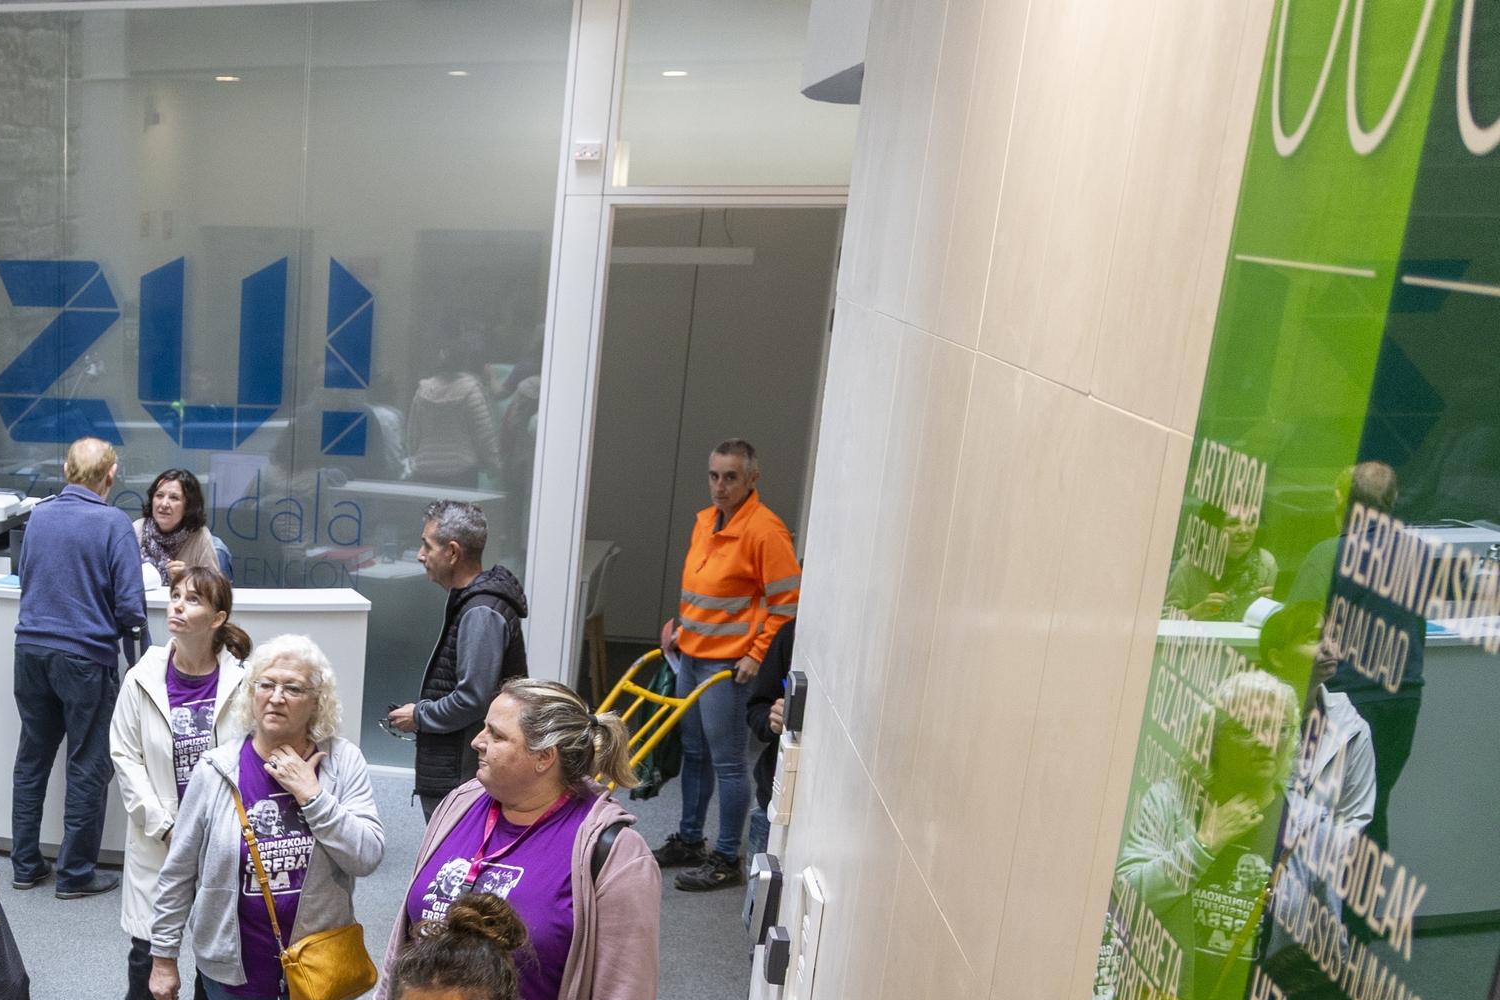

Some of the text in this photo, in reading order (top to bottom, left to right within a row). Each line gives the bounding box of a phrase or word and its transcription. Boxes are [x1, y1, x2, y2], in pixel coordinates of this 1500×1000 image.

[1190, 438, 1267, 530] ARTXIBOA
[1182, 513, 1230, 581] ARCHIVO
[1325, 594, 1410, 694] IGUALDAD
[1151, 665, 1217, 772] GIZARTEA
[1299, 707, 1349, 806] GIZA
[247, 845, 314, 862] ERESIDENTZ
[1282, 780, 1428, 963] BALIABIDEAK
[1268, 861, 1349, 983] RECURSOS
